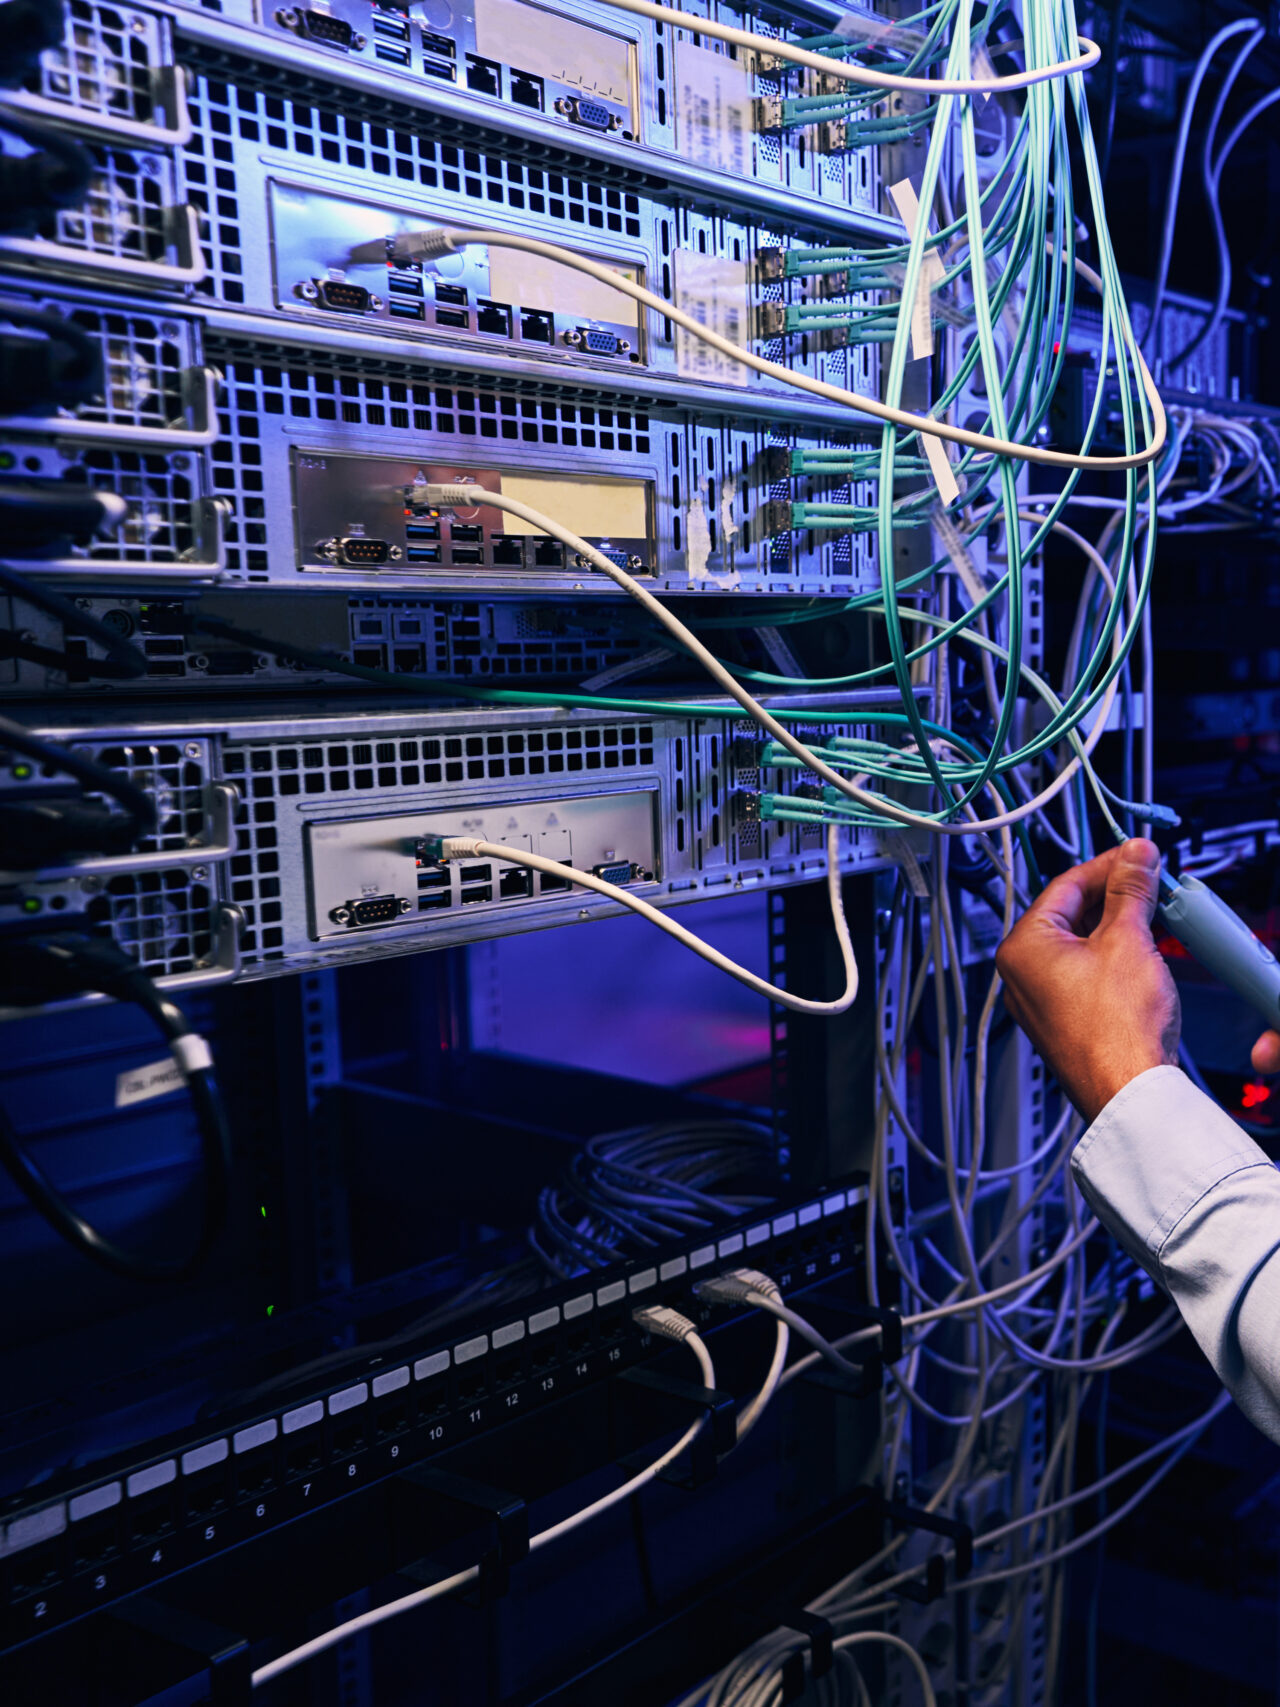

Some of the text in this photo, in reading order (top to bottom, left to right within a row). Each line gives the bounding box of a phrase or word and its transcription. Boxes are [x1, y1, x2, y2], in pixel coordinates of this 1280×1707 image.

[34, 1601, 47, 1618] 2
[94, 1575, 107, 1590] 3
[150, 1550, 163, 1564] 4
[204, 1525, 216, 1540] 5
[255, 1503, 266, 1517] 6
[302, 1483, 312, 1497] 7
[347, 1463, 358, 1477] 8
[390, 1445, 400, 1458] 9
[429, 1426, 444, 1441] 10
[469, 1409, 481, 1423] 11
[505, 1392, 520, 1407] 12
[541, 1377, 555, 1391] 13
[575, 1362, 589, 1376] 14
[608, 1348, 621, 1361] 15
